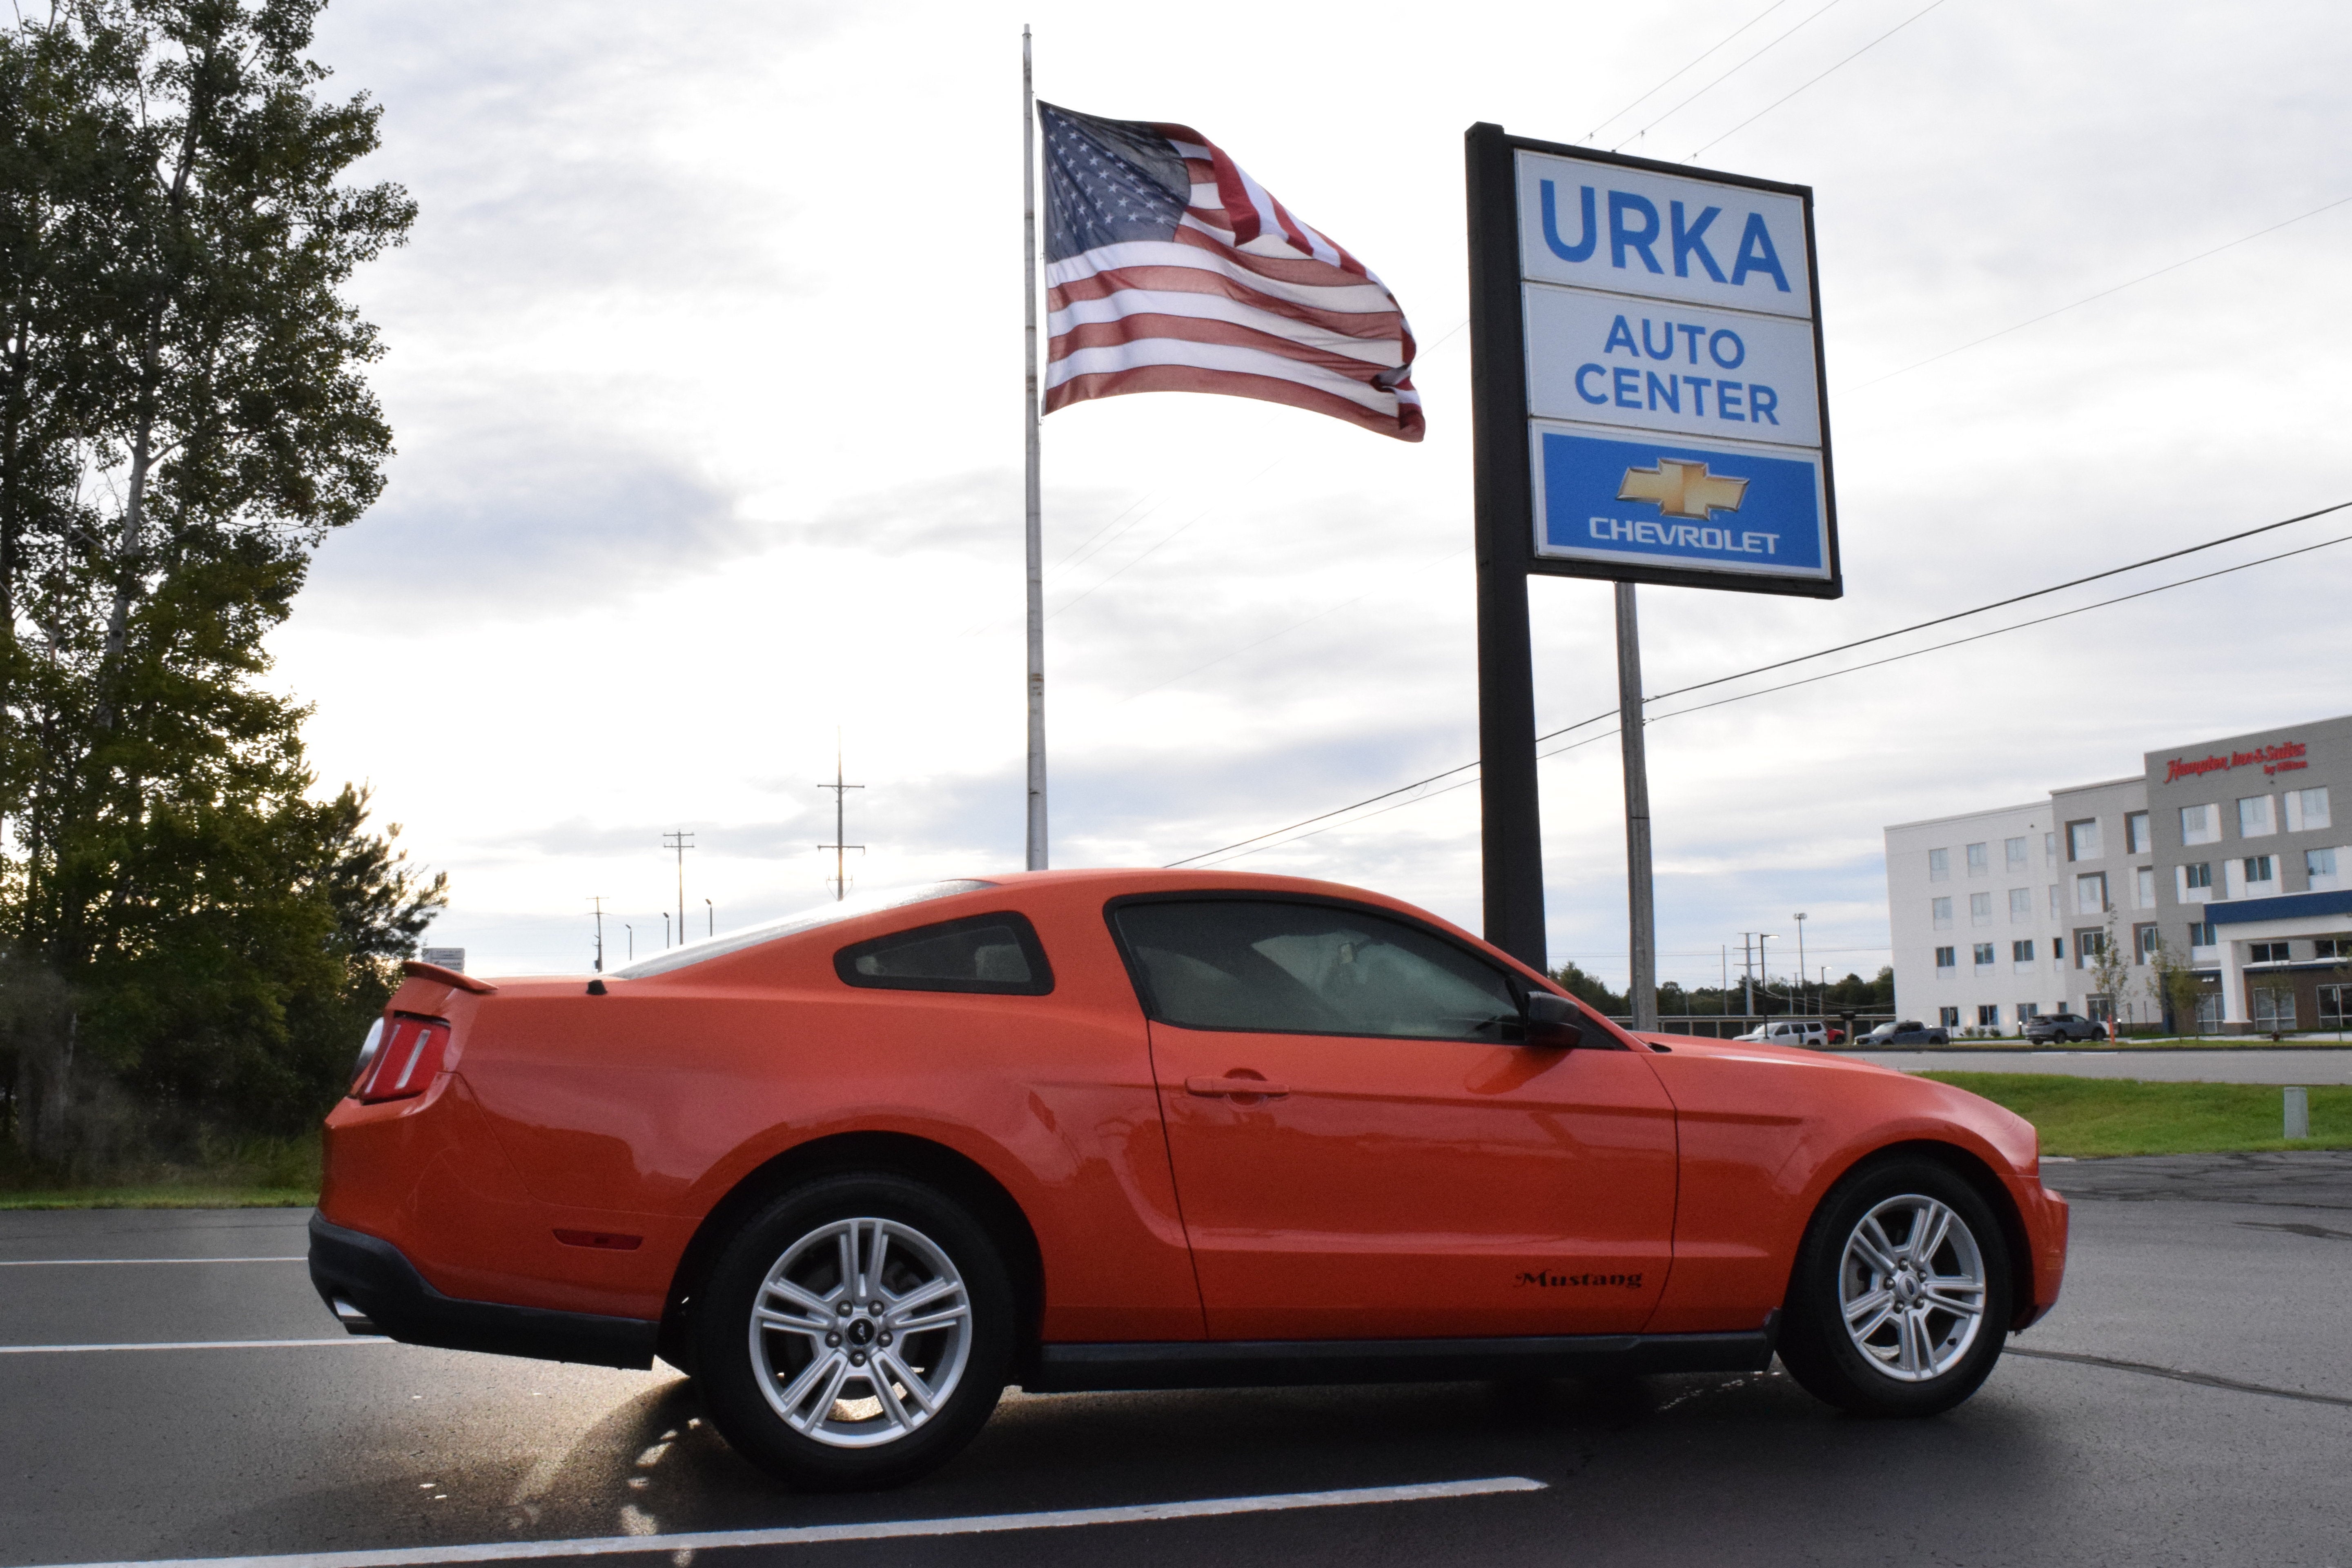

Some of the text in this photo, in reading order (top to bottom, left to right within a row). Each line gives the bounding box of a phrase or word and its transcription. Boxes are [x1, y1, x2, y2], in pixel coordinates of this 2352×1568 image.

[1540, 179, 1791, 293] URKA
[1604, 314, 1746, 370] AUTO
[1575, 363, 1780, 425] CENTER
[1589, 517, 1780, 555] CHEVROLET
[1512, 1269, 1643, 1289] Mustang
